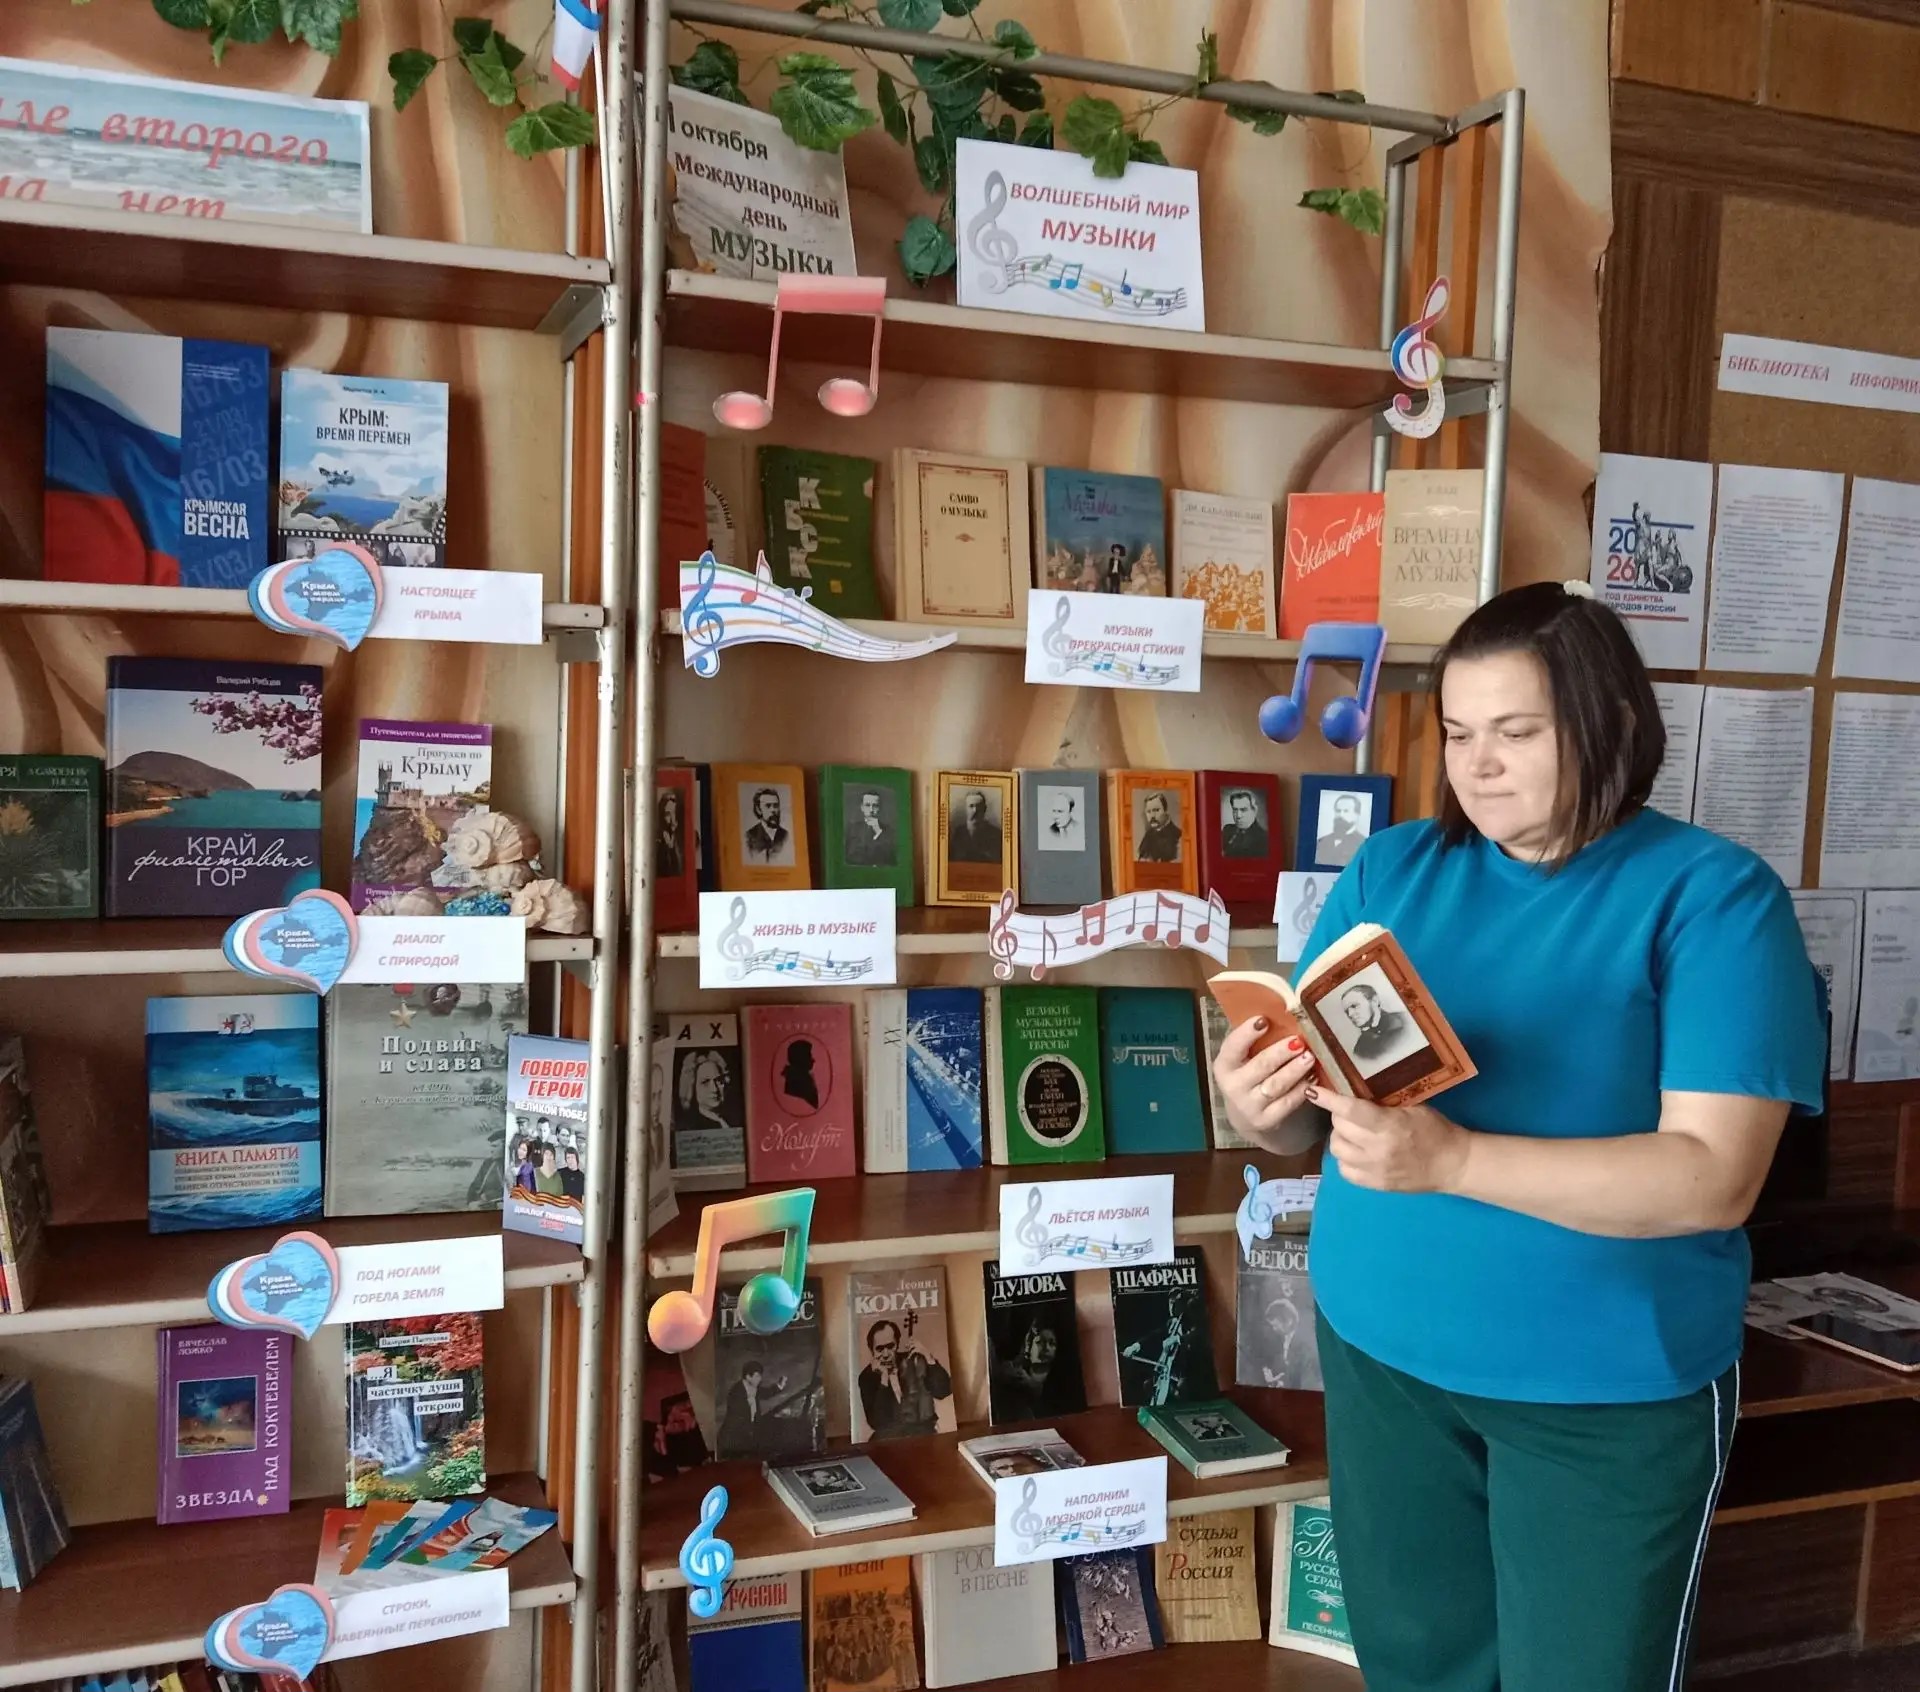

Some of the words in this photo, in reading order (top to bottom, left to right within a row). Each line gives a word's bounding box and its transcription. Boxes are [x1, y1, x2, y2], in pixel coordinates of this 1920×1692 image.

[0, 96, 70, 135] ле
[101, 113, 328, 169] второго
[681, 120, 768, 160] октября
[675, 152, 840, 219] Международный
[119, 190, 227, 219] нет
[1010, 182, 1140, 214] ВОЛШЕБНЫЙ
[1146, 201, 1190, 220] МИР
[742, 207, 788, 232] день
[1041, 218, 1156, 252] МУЗЫКИ
[1727, 355, 1830, 382] БИБЛИОТЕКА
[339, 407, 389, 428] КРЫМ:
[316, 426, 355, 442] ВРЕМЯ
[358, 428, 411, 446] ПЕРЕМЕН
[184, 498, 247, 516] КРЫМСКАЯ
[949, 492, 979, 505] СЛОВО
[949, 506, 988, 520] МУЗЫКЕ
[183, 513, 250, 540] ВЕСНА
[1608, 527, 1638, 554] 20
[1606, 555, 1637, 581] 26
[400, 585, 478, 600] НАСТОЯЩЕЕ
[414, 609, 462, 622] КРЫМА
[1104, 625, 1153, 637] МУЗЫКИ
[1068, 639, 1141, 654] ПРЕКРАСНАЯ
[1143, 643, 1186, 656] СТИХИЯ
[417, 747, 466, 760] Прогулки
[400, 756, 472, 780] Крыму
[187, 832, 257, 856] КРАЙ
[128, 838, 313, 882] фиолетовых
[196, 868, 247, 887] ГОР
[753, 923, 804, 937] ЖИЗНЬ
[808, 923, 816, 935] В
[819, 921, 877, 934] МУЗЫКЕ
[393, 934, 446, 946] ДИАЛОГ
[378, 955, 387, 966] С
[389, 953, 460, 968] ПРИРОДОЙ
[1026, 1005, 1071, 1016] ВЕЛИКИЕ
[1016, 1016, 1082, 1027] МУЗЫКАНТЫ
[1020, 1028, 1078, 1039] ЗАПАДНОЙ
[381, 1034, 482, 1055] Подвиг
[1029, 1039, 1071, 1050] ЕВРОПЫ
[380, 1061, 392, 1073] и
[406, 1056, 483, 1073] слава
[1133, 1053, 1168, 1066] ГРИГ
[528, 1079, 585, 1099] ГЕРОИ
[515, 1102, 557, 1116] ВЕЛИКОЙ
[175, 1149, 227, 1166] КНИГА
[233, 1147, 299, 1163] ПАМЯТИ
[1049, 1209, 1095, 1225] ЛЬЁТСЯ
[1097, 1206, 1150, 1221] МУЗЫКА
[356, 1268, 385, 1282] ПОД
[387, 1264, 441, 1278] НОГАМИ
[1116, 1267, 1197, 1288] ШАФРАН
[352, 1290, 400, 1305] ГОРЕЛА
[402, 1286, 445, 1302] ЗЕМЛЯ
[992, 1274, 1067, 1301] ДУЛОВА
[855, 1289, 938, 1313] КОГАН
[178, 1337, 228, 1348] ВЯЧЕСЛАВ
[178, 1346, 213, 1356] ЛОЖКО
[263, 1336, 280, 1449] КОКТЕБЕЛЕМ
[371, 1383, 425, 1398] частичку
[428, 1380, 461, 1395] души
[417, 1400, 461, 1414] открою
[264, 1454, 279, 1490] НАД
[176, 1489, 254, 1508] ЗВЕЗДА
[1064, 1488, 1130, 1507] НАПОЛНИМ
[1045, 1507, 1103, 1527] МУЗЫКОЙ
[1105, 1501, 1146, 1518] СЕРДЦА
[1179, 1527, 1239, 1547] судьба
[1166, 1553, 1234, 1580] Россия
[961, 1577, 971, 1593] В
[975, 1569, 1029, 1592] ПЕСНЕ
[381, 1598, 432, 1615] СТРОКИ,
[332, 1621, 405, 1645] НАВЕЯННЫЕ
[409, 1610, 483, 1632] ПЕРЕКОПОМ
